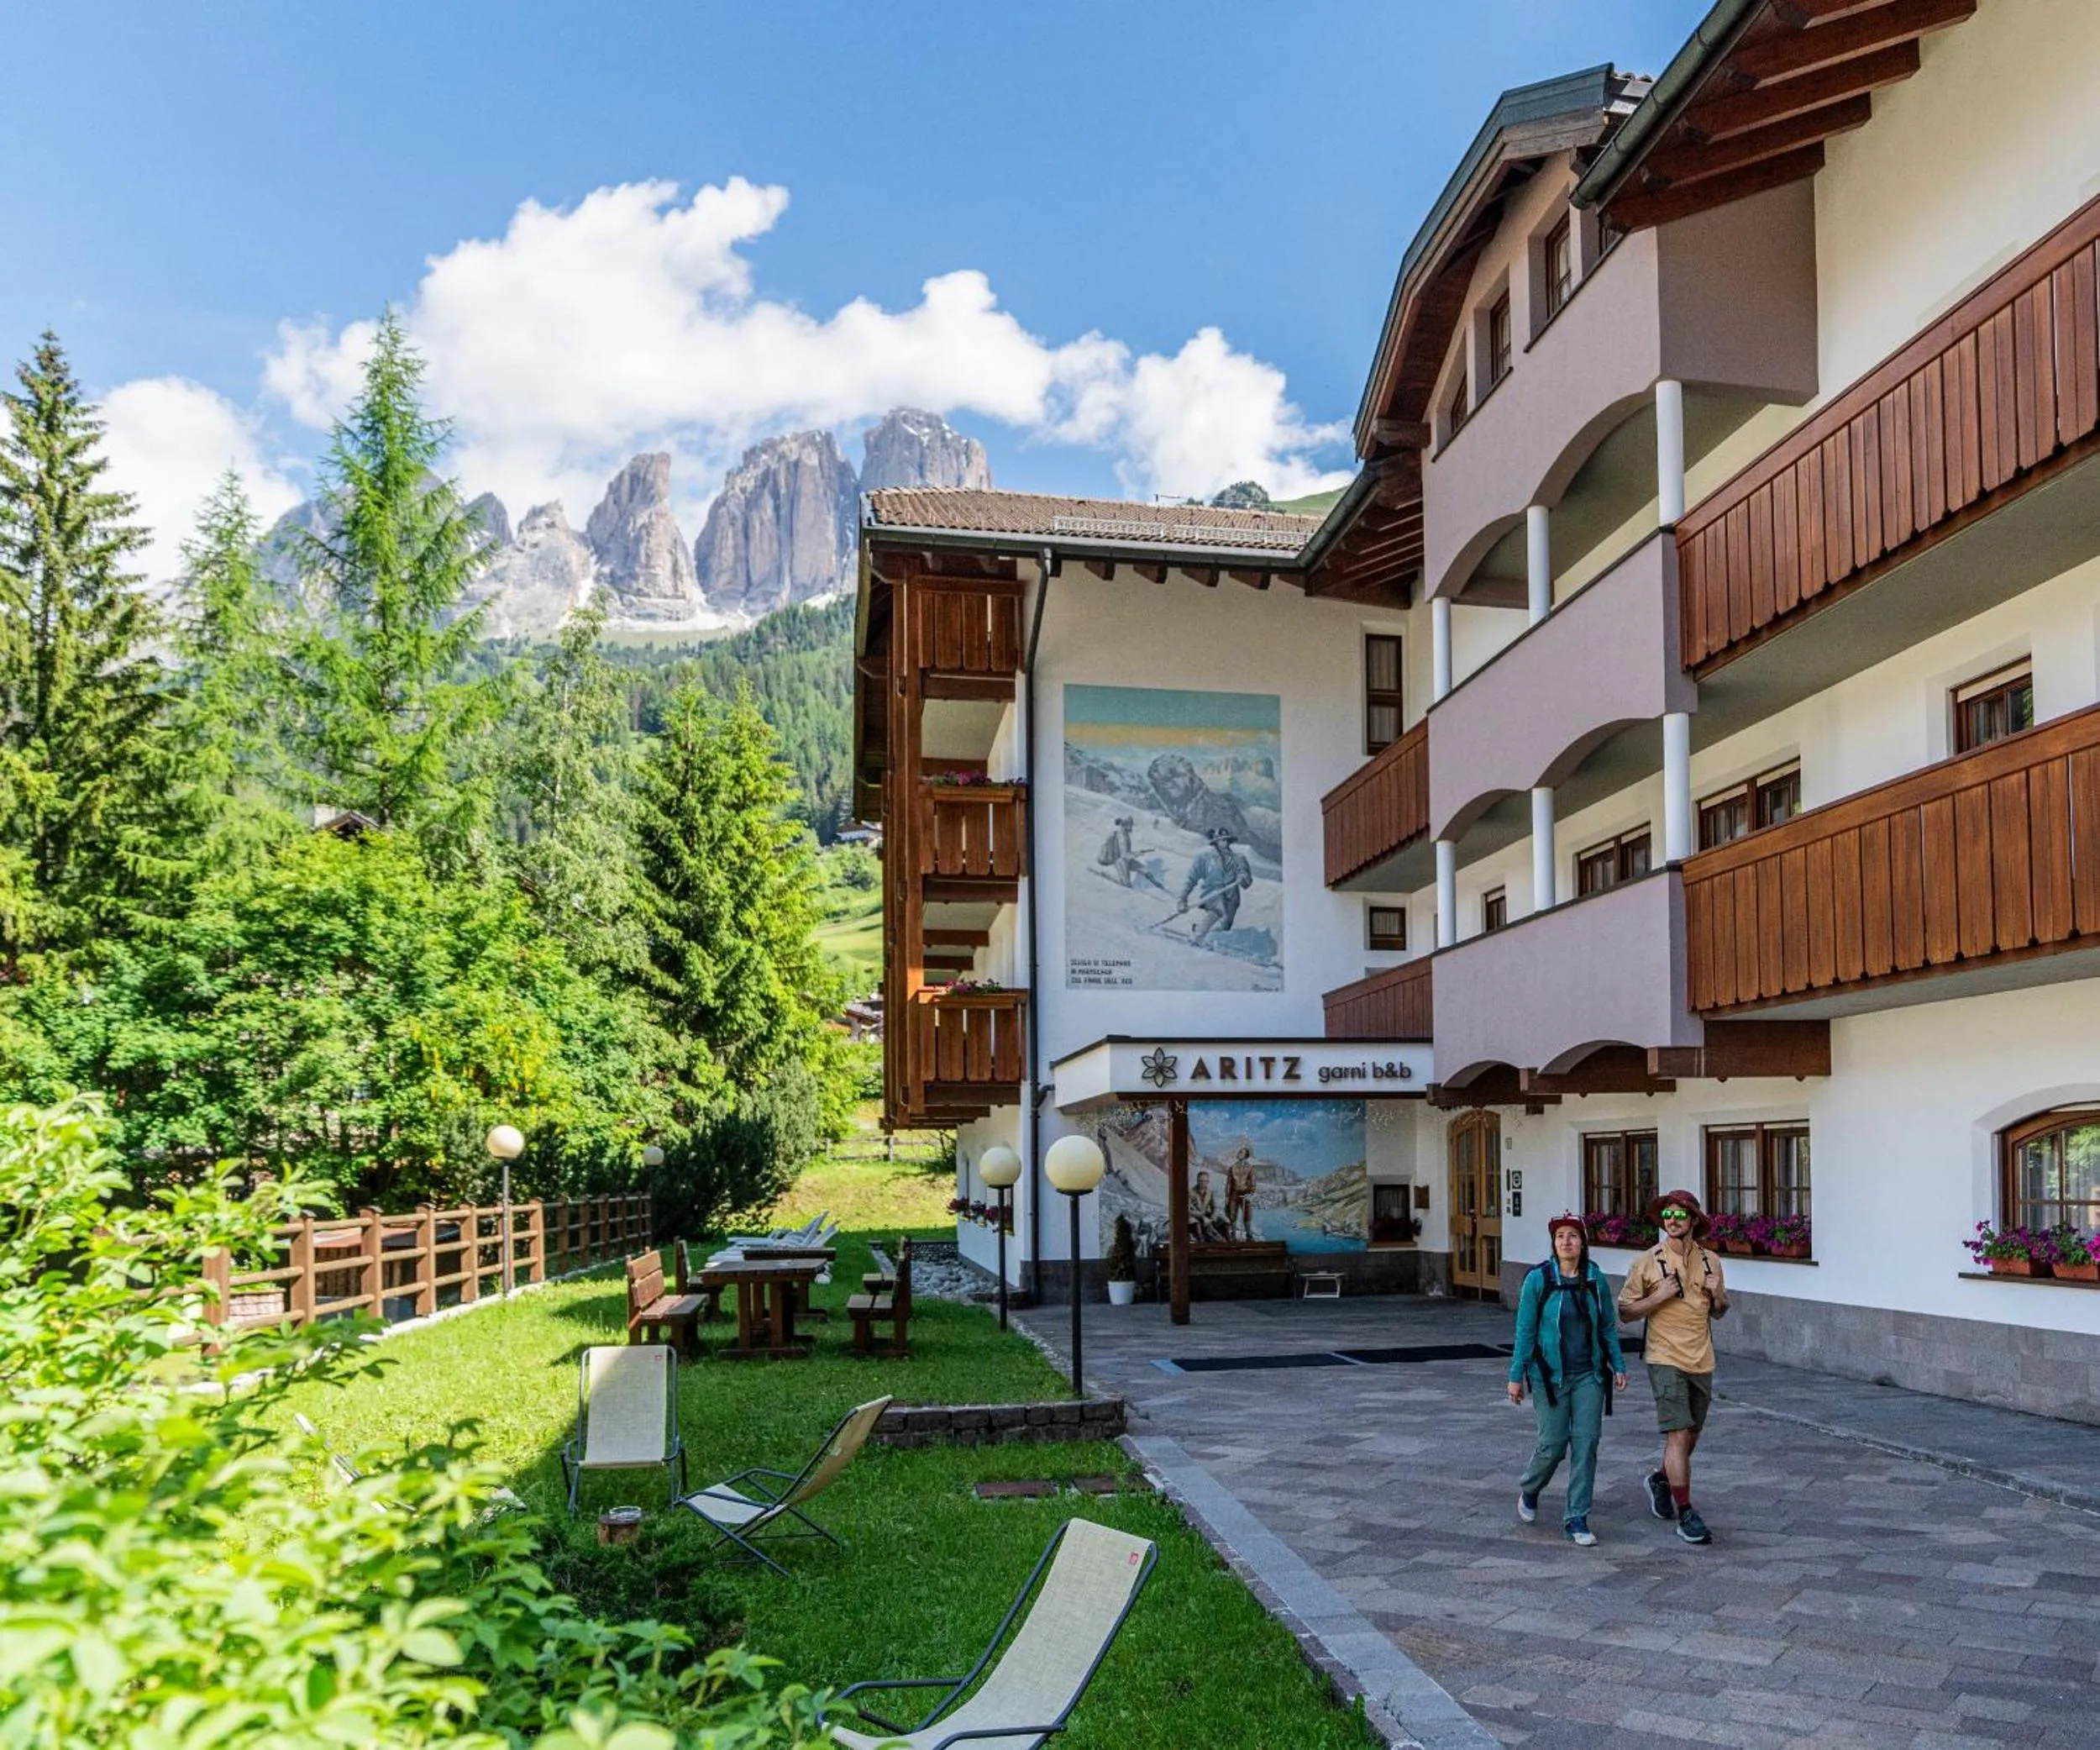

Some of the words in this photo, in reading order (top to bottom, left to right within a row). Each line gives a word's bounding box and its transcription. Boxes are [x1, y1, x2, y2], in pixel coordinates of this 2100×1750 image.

[1189, 1055, 1302, 1080] ARITZ
[1318, 1061, 1367, 1083] garni
[1371, 1061, 1412, 1079] b&b
